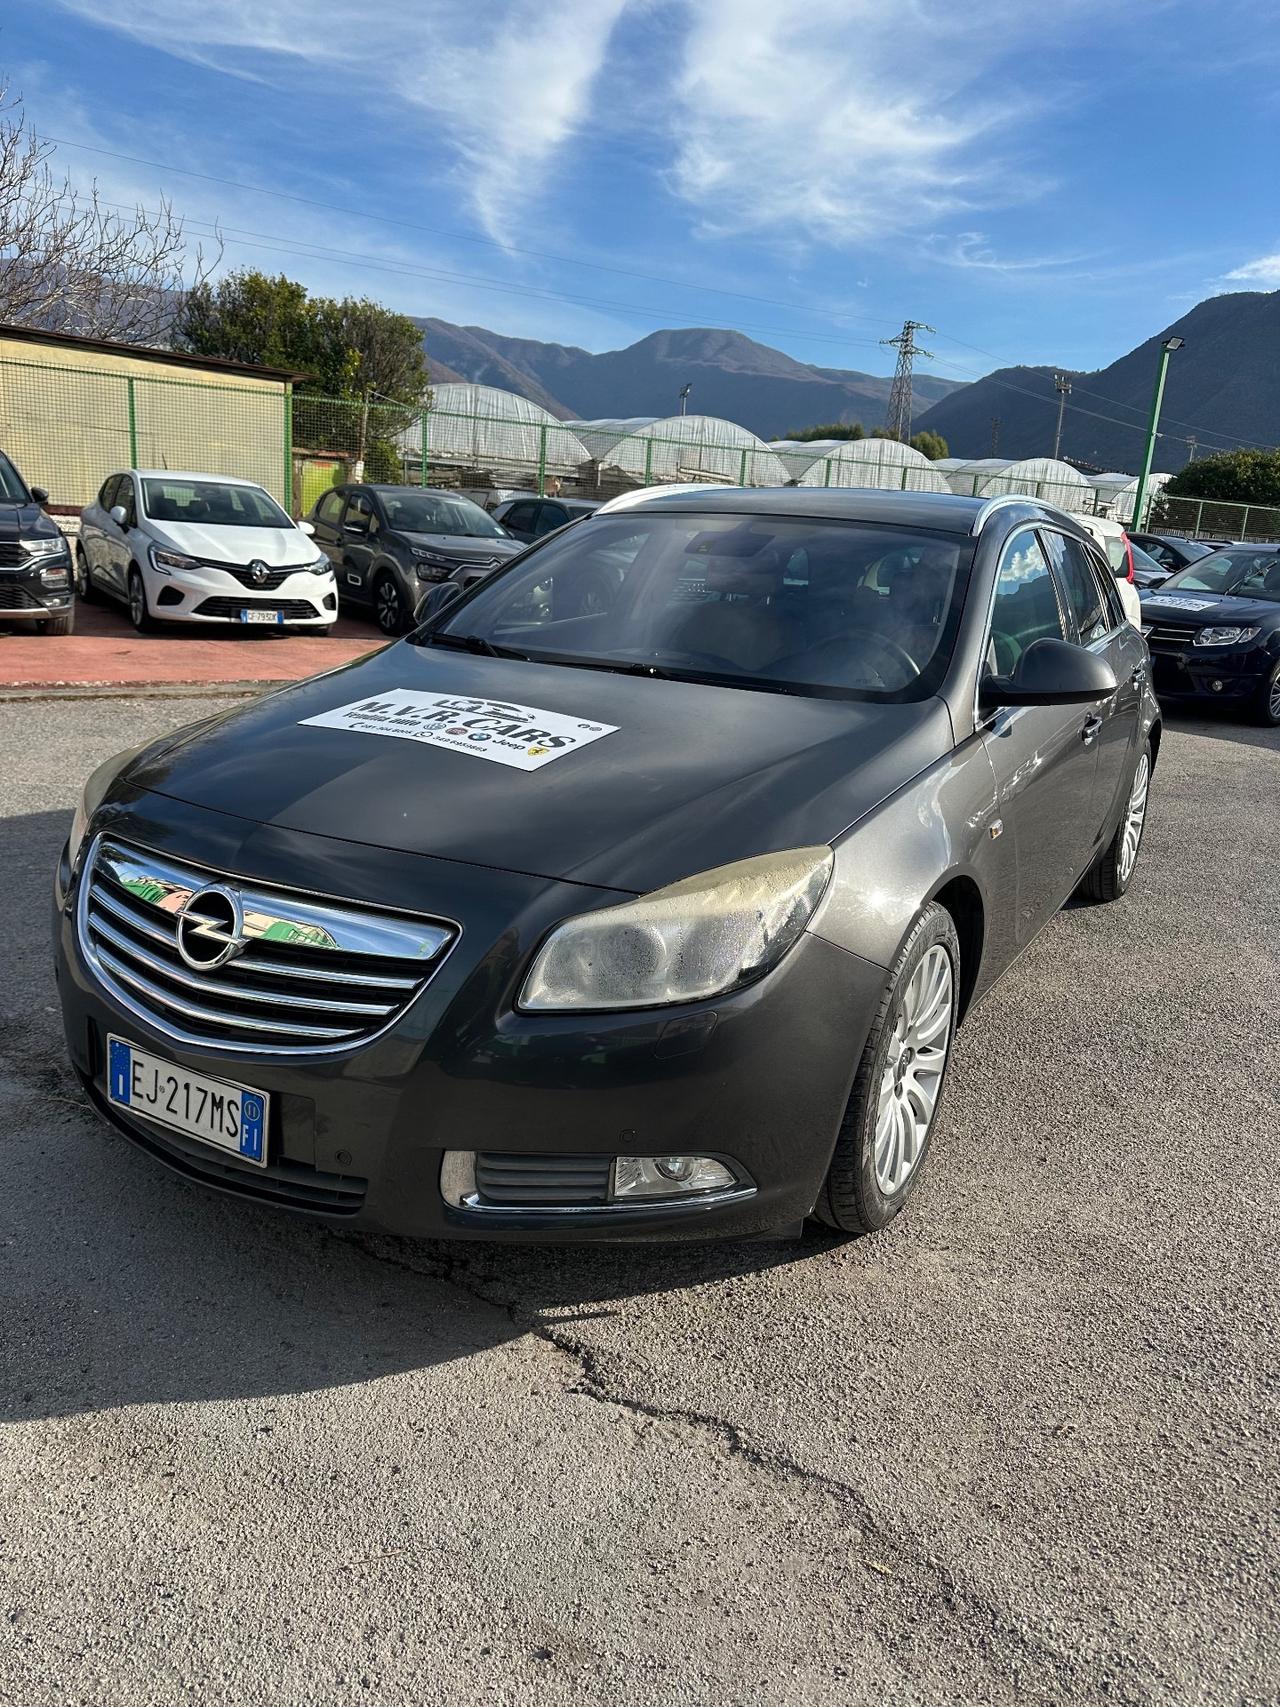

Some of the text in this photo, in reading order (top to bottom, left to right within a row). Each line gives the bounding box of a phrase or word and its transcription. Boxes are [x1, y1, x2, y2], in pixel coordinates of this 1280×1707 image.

[351, 701, 459, 724] M.V.R.
[462, 718, 576, 748] CARS
[492, 739, 526, 750] Jeep
[242, 1123, 258, 1151] FI
